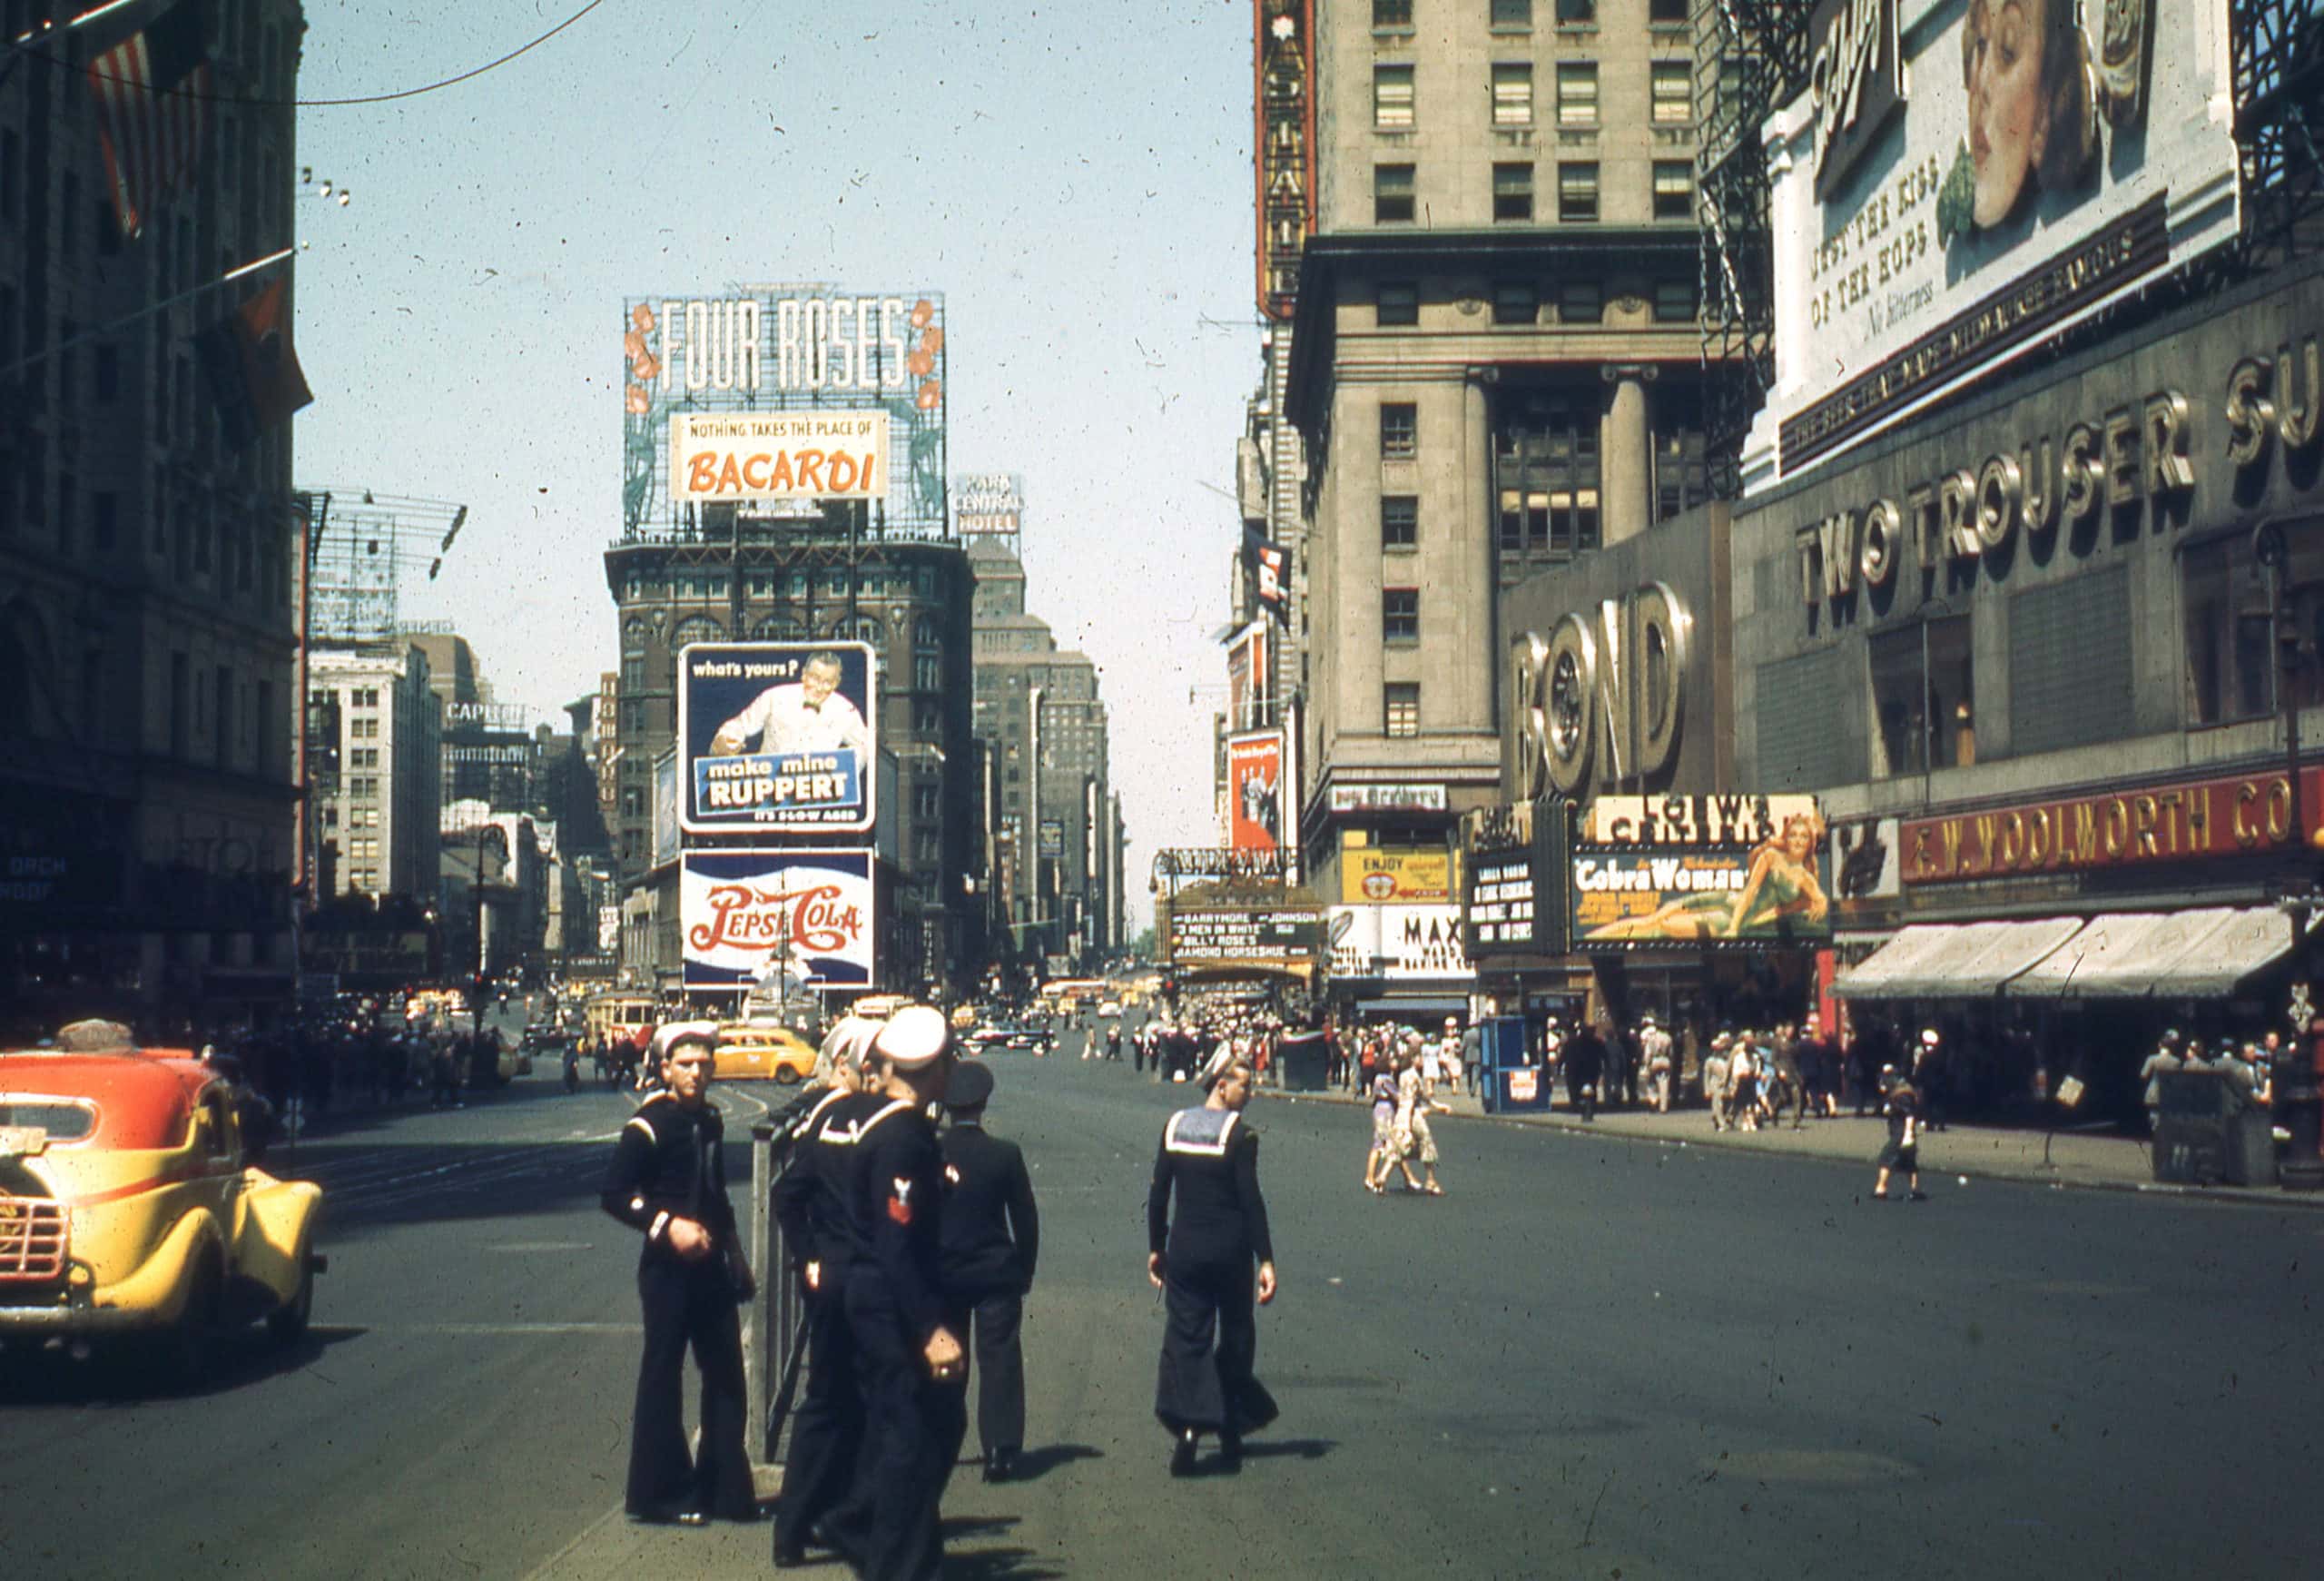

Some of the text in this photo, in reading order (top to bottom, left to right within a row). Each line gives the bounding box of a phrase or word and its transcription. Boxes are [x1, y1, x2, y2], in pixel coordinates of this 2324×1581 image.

[1811, 154, 1939, 282] JUST THE KISS
[1811, 221, 1926, 330] OF THE HOPS
[662, 298, 906, 391] FOUR ROSES
[1823, 394, 1856, 430] BEER
[2053, 228, 2132, 300] FAMOUS
[690, 420, 872, 439] NOTHING TAKES THE PLACE OF
[687, 449, 874, 495] BACARDI
[1796, 332, 2322, 607] TWO TROUSER SU
[959, 514, 1017, 532] HOTEL
[694, 660, 798, 678] what's yours?
[1510, 581, 1691, 795] BOND
[708, 756, 839, 779] make mine
[708, 773, 848, 806] RUPPERT
[1976, 786, 2212, 874] WOOLWORTH
[2233, 777, 2291, 849] CO
[1363, 857, 1403, 872] ENJOY
[1184, 913, 1249, 924] BARRYMORE
[1268, 913, 1317, 923] JOHNSON
[1188, 924, 1212, 934] MEN
[1214, 924, 1226, 934] IN
[1184, 935, 1256, 946] BILLY ROSE'S
